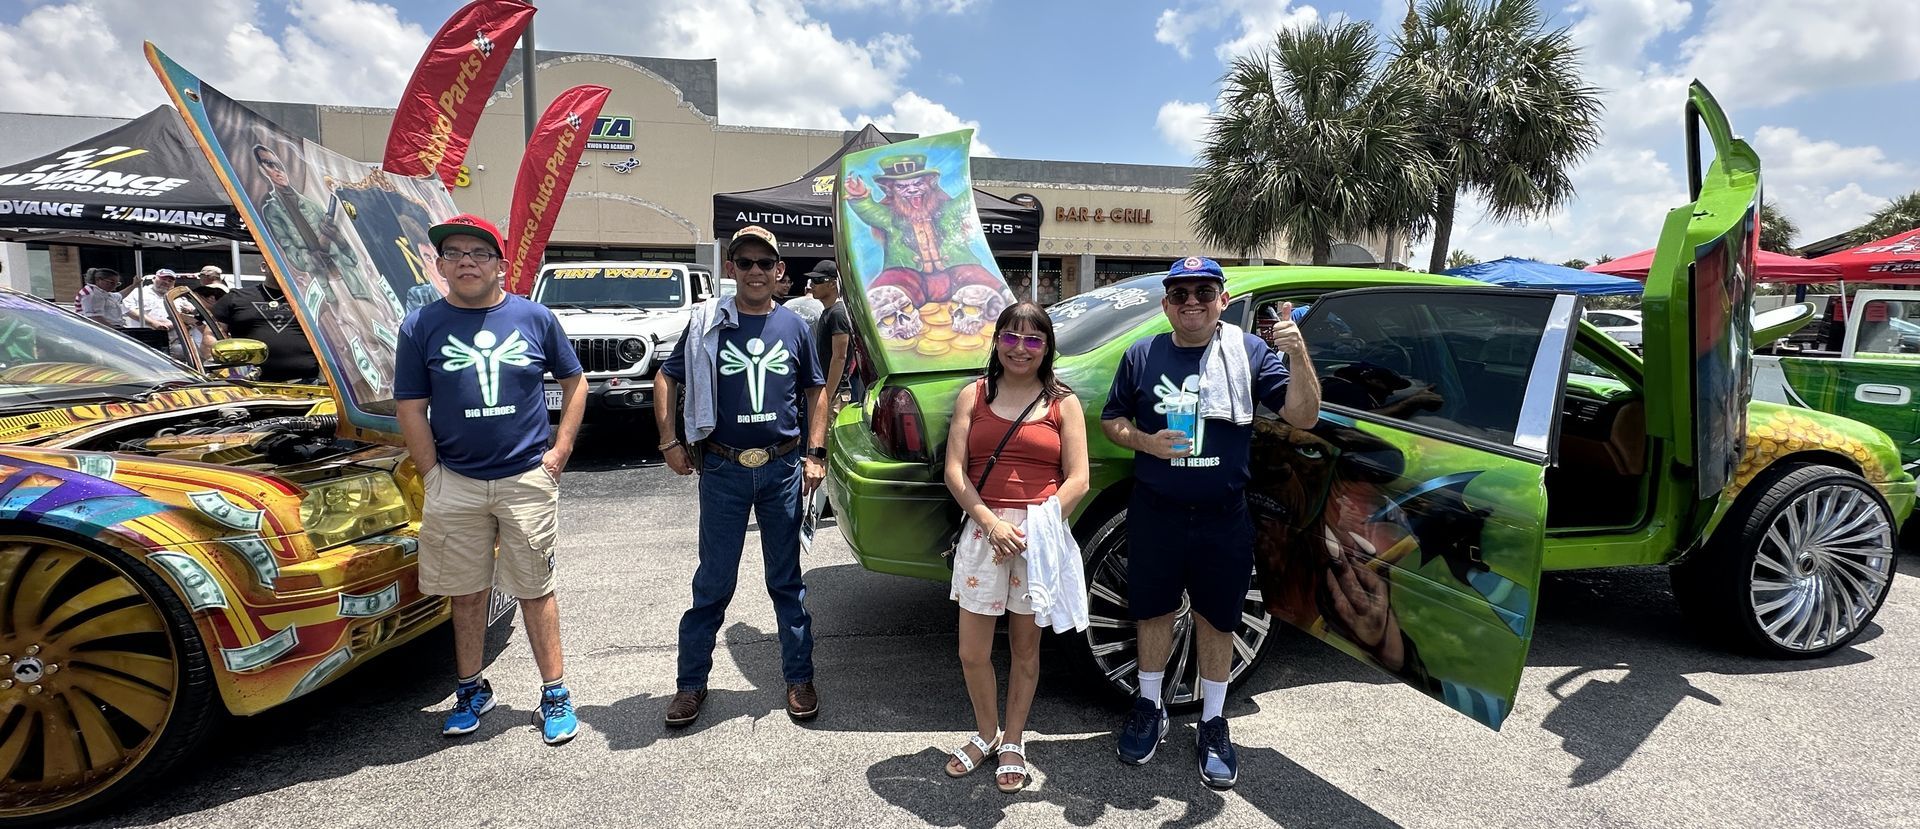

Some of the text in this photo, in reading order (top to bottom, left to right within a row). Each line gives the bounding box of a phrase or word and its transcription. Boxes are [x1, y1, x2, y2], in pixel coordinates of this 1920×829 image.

[418, 113, 453, 173] Auto
[438, 53, 482, 120] Parts
[0, 168, 190, 192] ADVANCE
[30, 183, 163, 197] AUTO PARTS
[127, 206, 227, 228] ADVANCE
[508, 128, 576, 293] Advance Auto Parts
[1055, 206, 1154, 224] BAR & GRILL
[553, 268, 674, 280] TINT WORLD
[482, 405, 516, 417] HEROES
[751, 412, 777, 423] HEROES
[1187, 456, 1220, 467] HEROES
